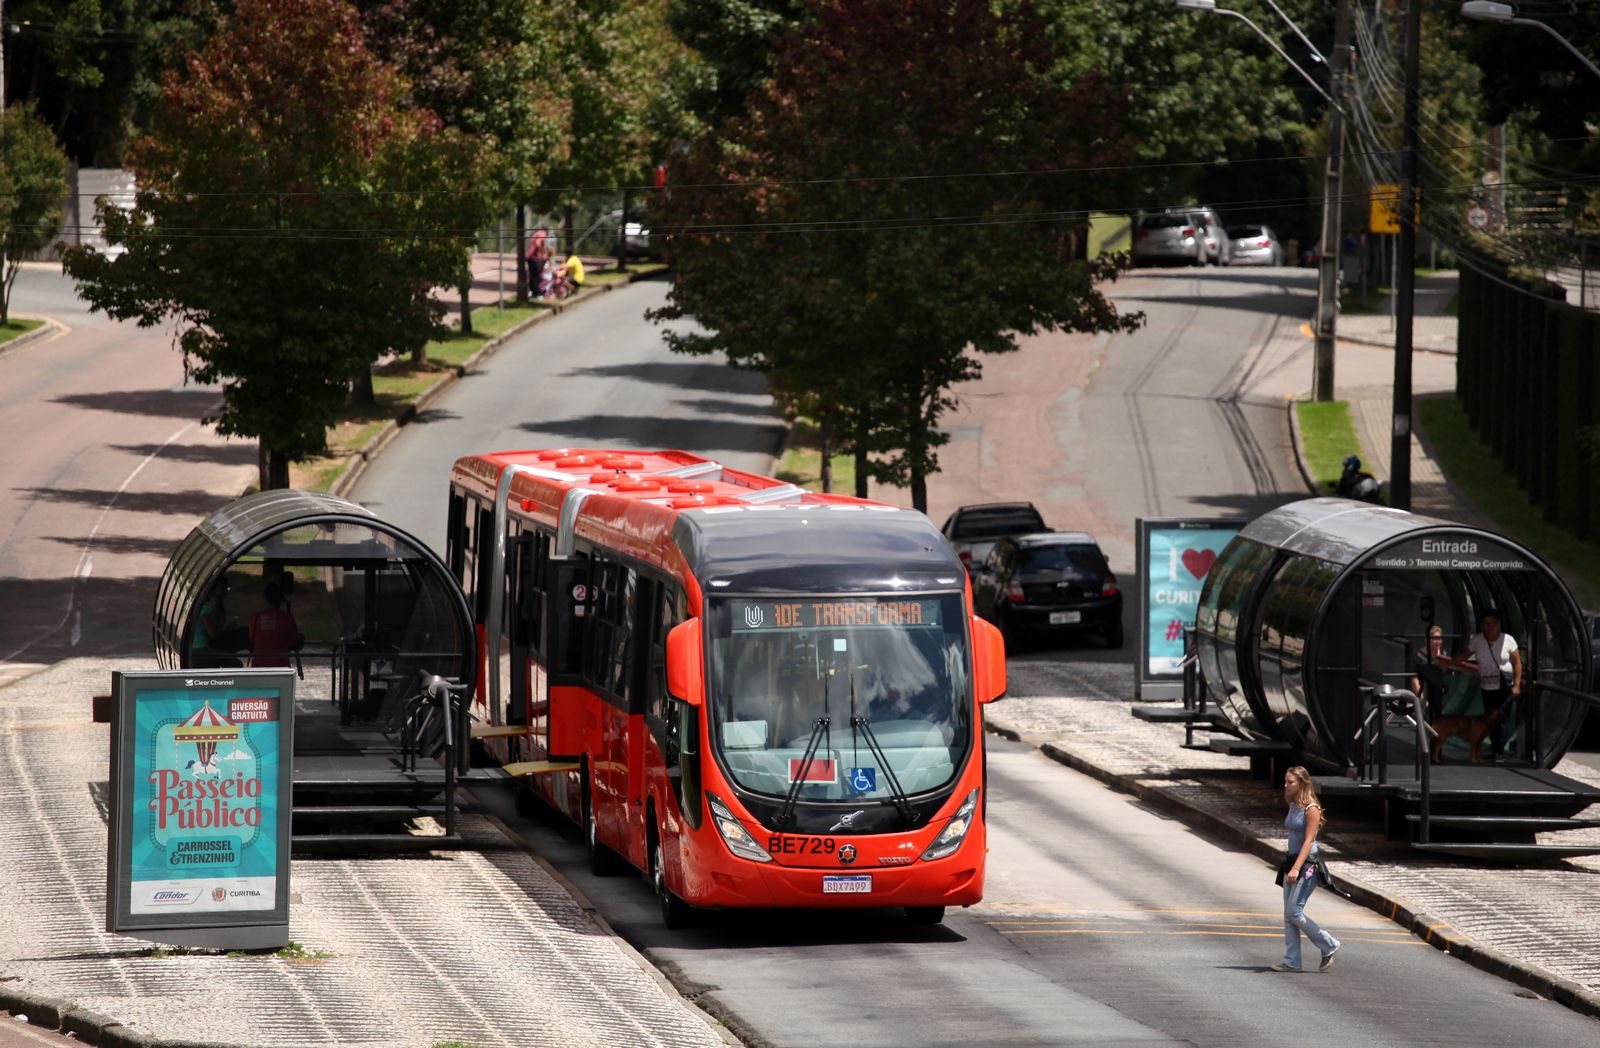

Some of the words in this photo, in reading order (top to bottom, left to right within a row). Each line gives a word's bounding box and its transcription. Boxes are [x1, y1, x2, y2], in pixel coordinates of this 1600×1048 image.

[1422, 539, 1478, 553] Entrada
[1169, 547, 1177, 581] I
[1375, 558, 1407, 567] Sentido
[1416, 558, 1450, 568] Terminal
[1451, 559, 1481, 569] Campo
[1482, 559, 1524, 569] Comprido
[576, 586, 584, 598] 2
[812, 602, 922, 625] TRANSFORMA
[231, 700, 268, 711] DIVERSÃO
[231, 711, 268, 720] GRATUITA
[149, 769, 262, 799] Passeio
[149, 795, 262, 830] Público
[177, 840, 233, 852] CARROSSEL
[769, 837, 835, 853] BE729
